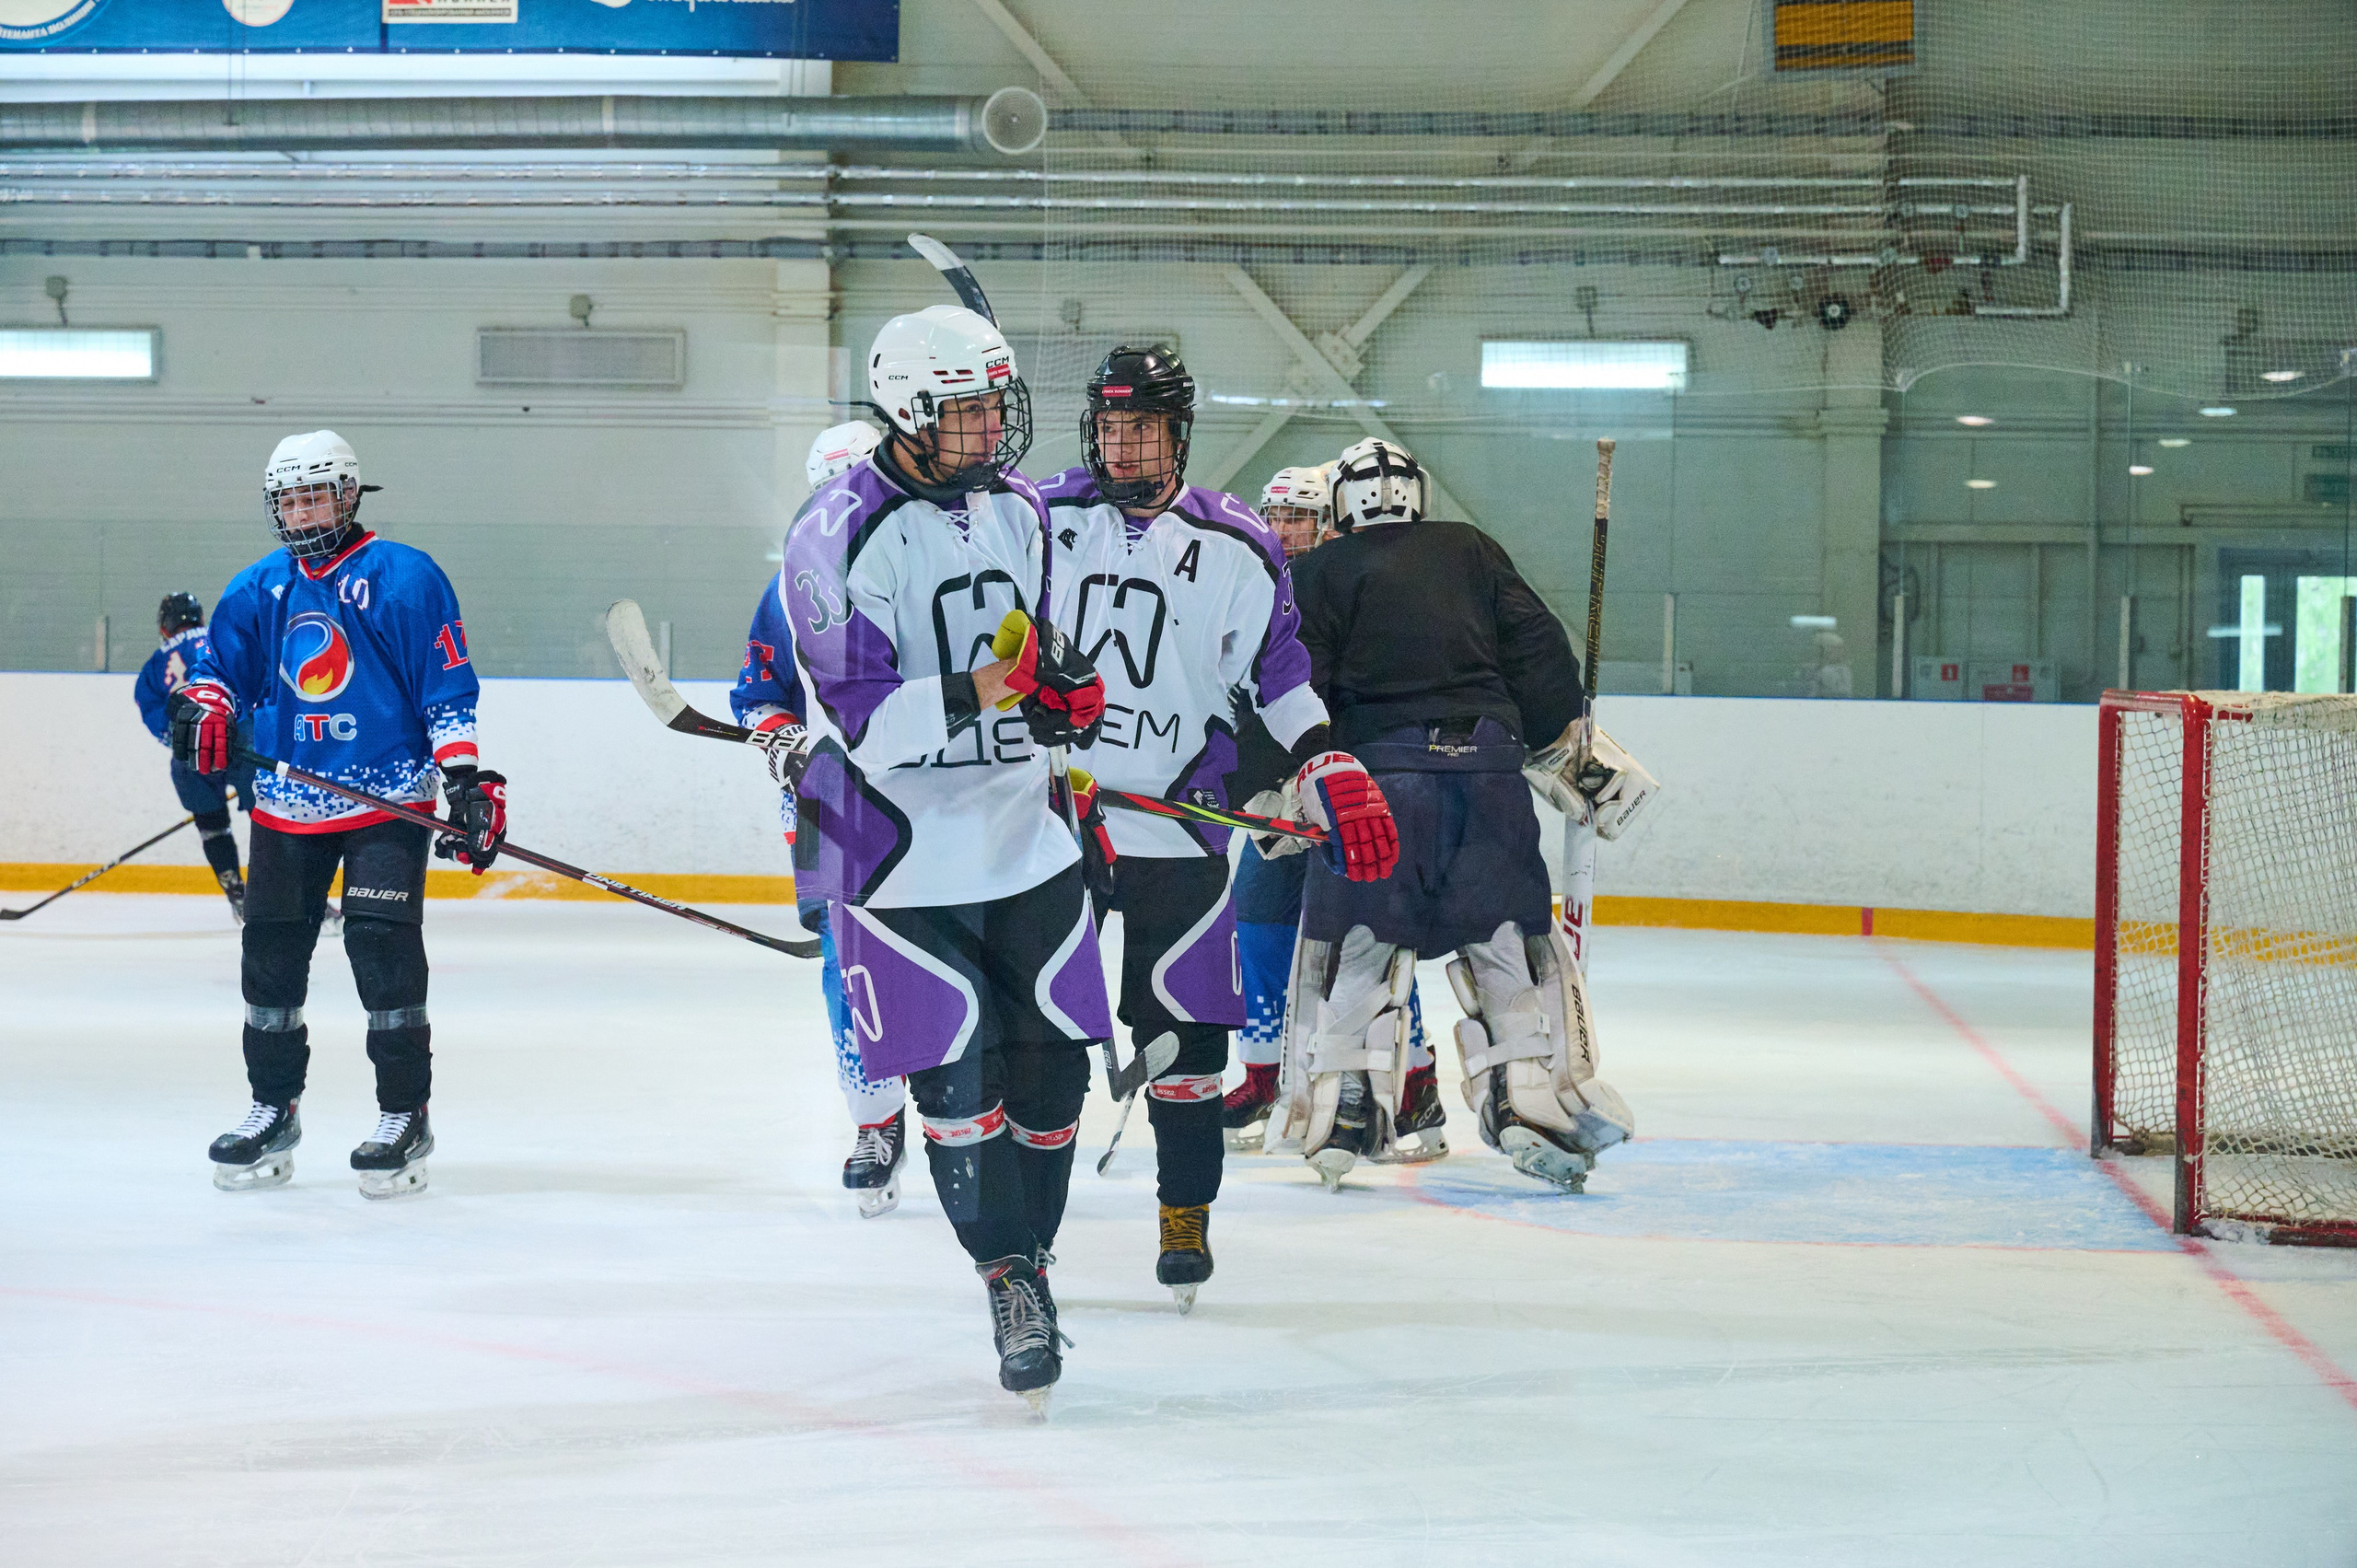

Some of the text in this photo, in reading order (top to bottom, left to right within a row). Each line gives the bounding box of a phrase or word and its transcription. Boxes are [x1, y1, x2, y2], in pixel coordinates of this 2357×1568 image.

[986, 355, 1009, 369] CCM
[276, 465, 301, 473] CCM
[1173, 539, 1202, 583] A
[1428, 744, 1478, 753] PREMIER
[1296, 752, 1355, 794] RUE
[445, 784, 460, 796] CCM
[1616, 789, 1647, 826] BAUER
[346, 887, 410, 903] BAUER
[1572, 983, 1591, 1064] BAUER
